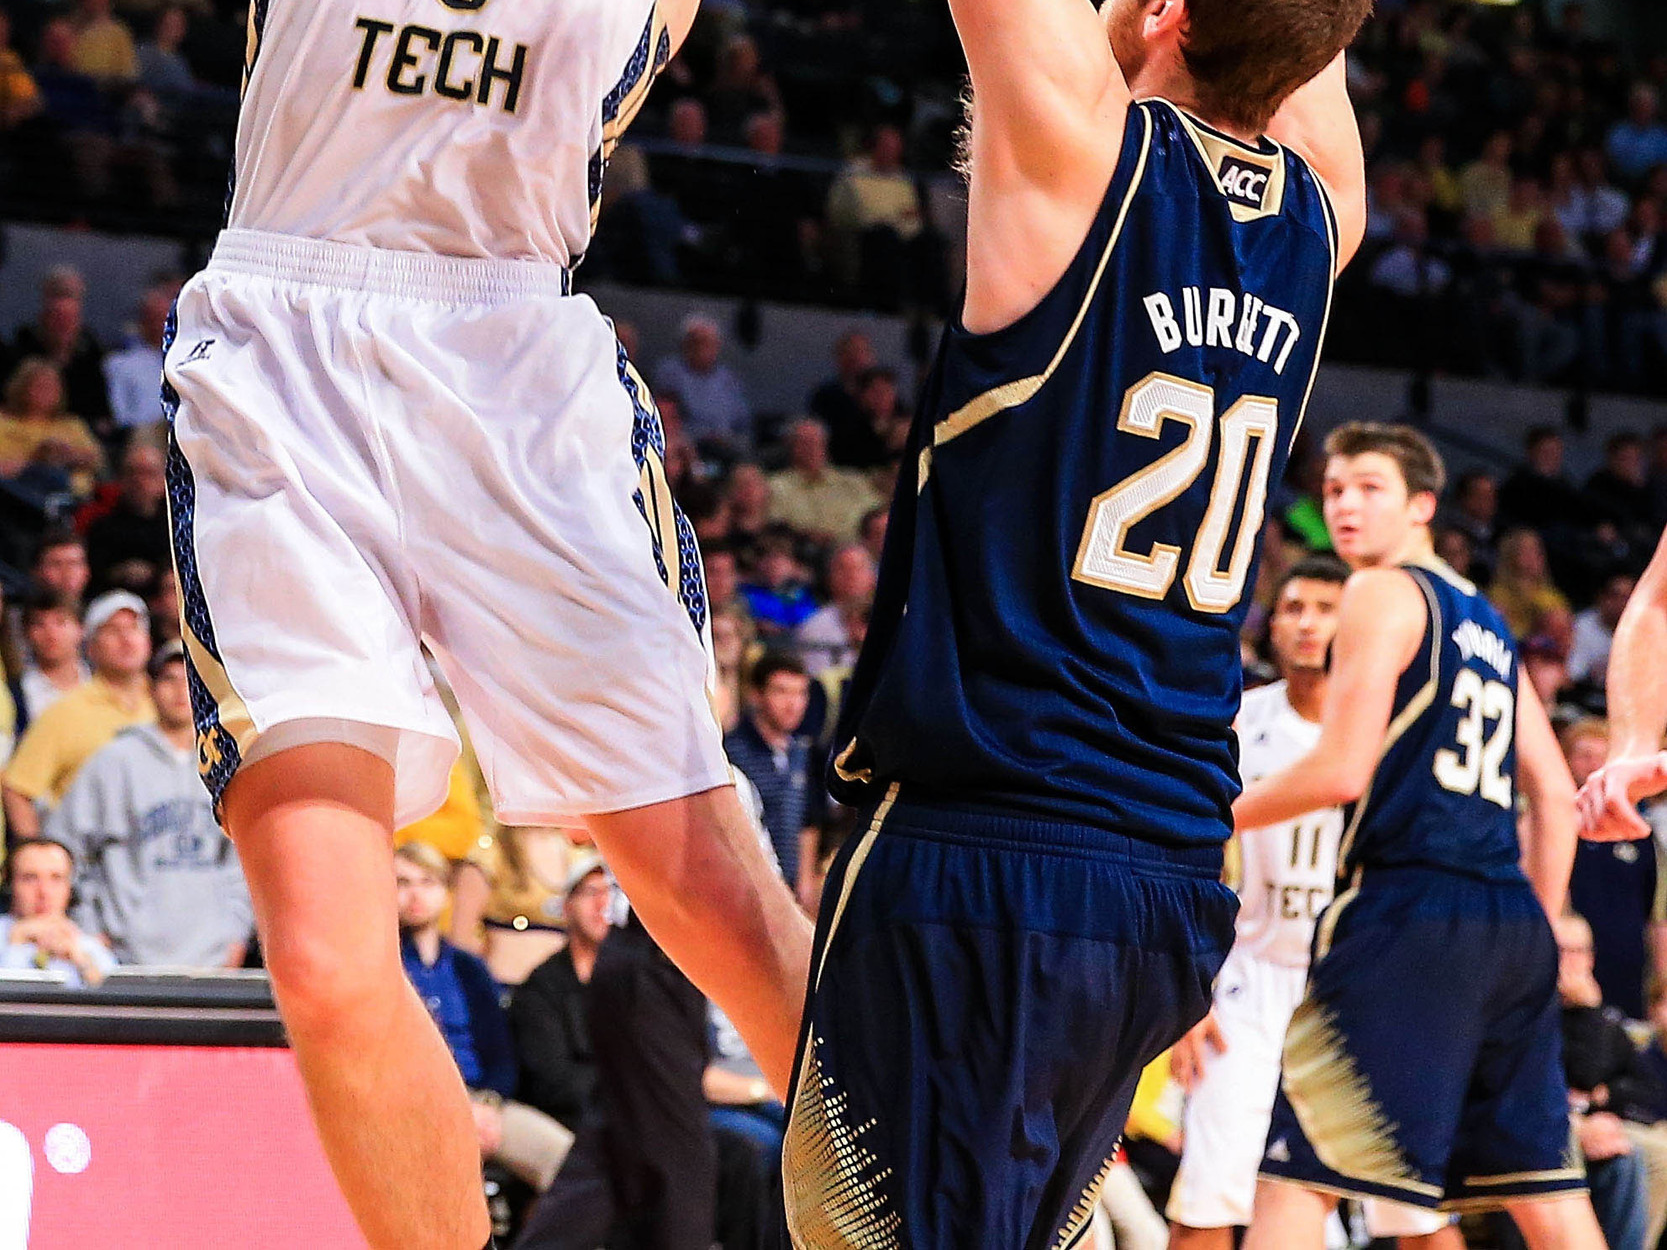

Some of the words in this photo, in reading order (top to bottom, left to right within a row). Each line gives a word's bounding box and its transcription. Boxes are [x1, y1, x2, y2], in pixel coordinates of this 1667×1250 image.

[352, 17, 528, 115] TECH
[1220, 165, 1268, 203] ACC
[1071, 370, 1279, 614] 20
[1432, 667, 1515, 811] 32
[1288, 823, 1321, 871] 11
